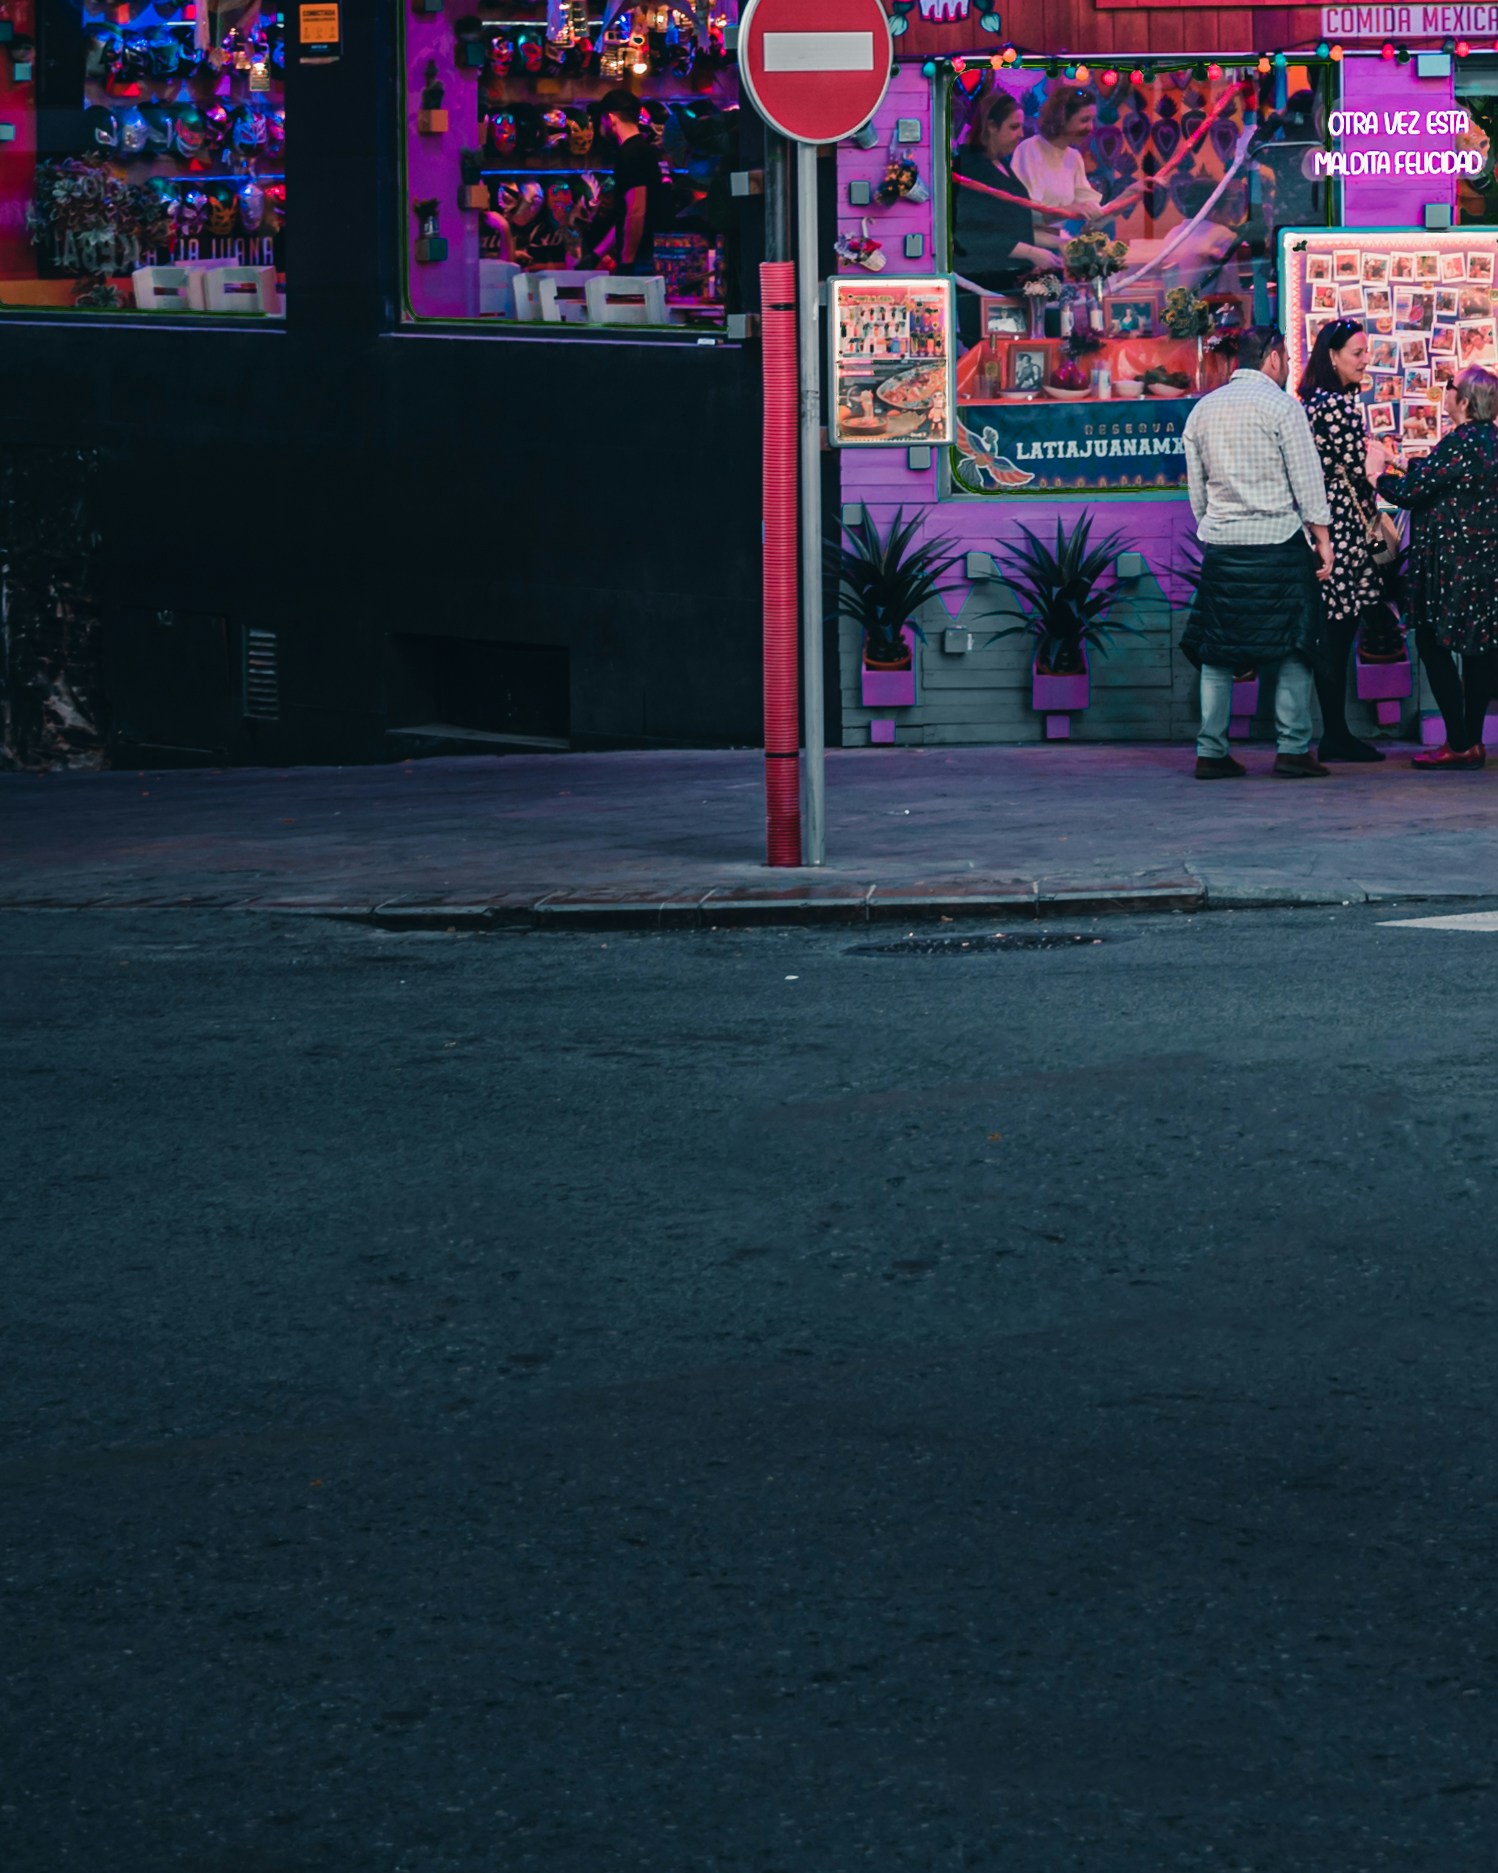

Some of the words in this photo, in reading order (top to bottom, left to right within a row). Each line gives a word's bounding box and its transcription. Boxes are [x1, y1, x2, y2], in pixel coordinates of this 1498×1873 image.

[1326, 7, 1411, 33] COMIDA
[1328, 111, 1379, 136] OTRA
[1384, 110, 1421, 135] VEZ
[1426, 110, 1470, 135] ESTA
[1313, 150, 1391, 176] MALDITA
[1394, 150, 1483, 175] FELICIDAD
[1084, 422, 1175, 436] RESERVA
